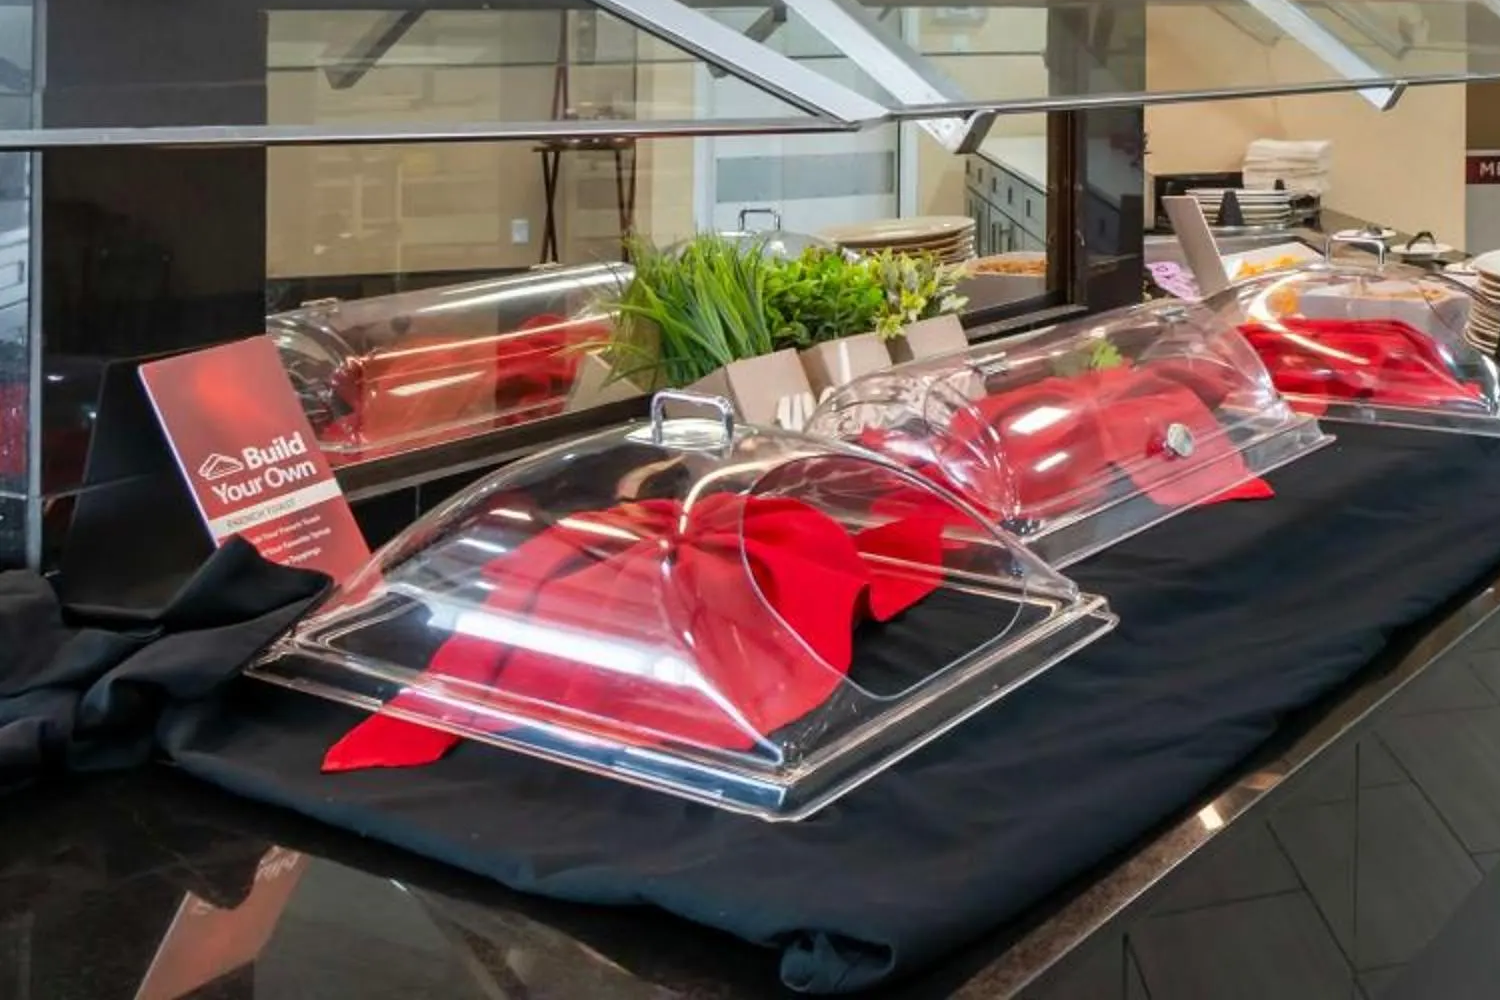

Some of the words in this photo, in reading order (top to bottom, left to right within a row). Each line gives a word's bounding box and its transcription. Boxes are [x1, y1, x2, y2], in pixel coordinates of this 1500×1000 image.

[241, 431, 308, 470] Build
[211, 476, 263, 505] Your
[264, 460, 317, 488] Own
